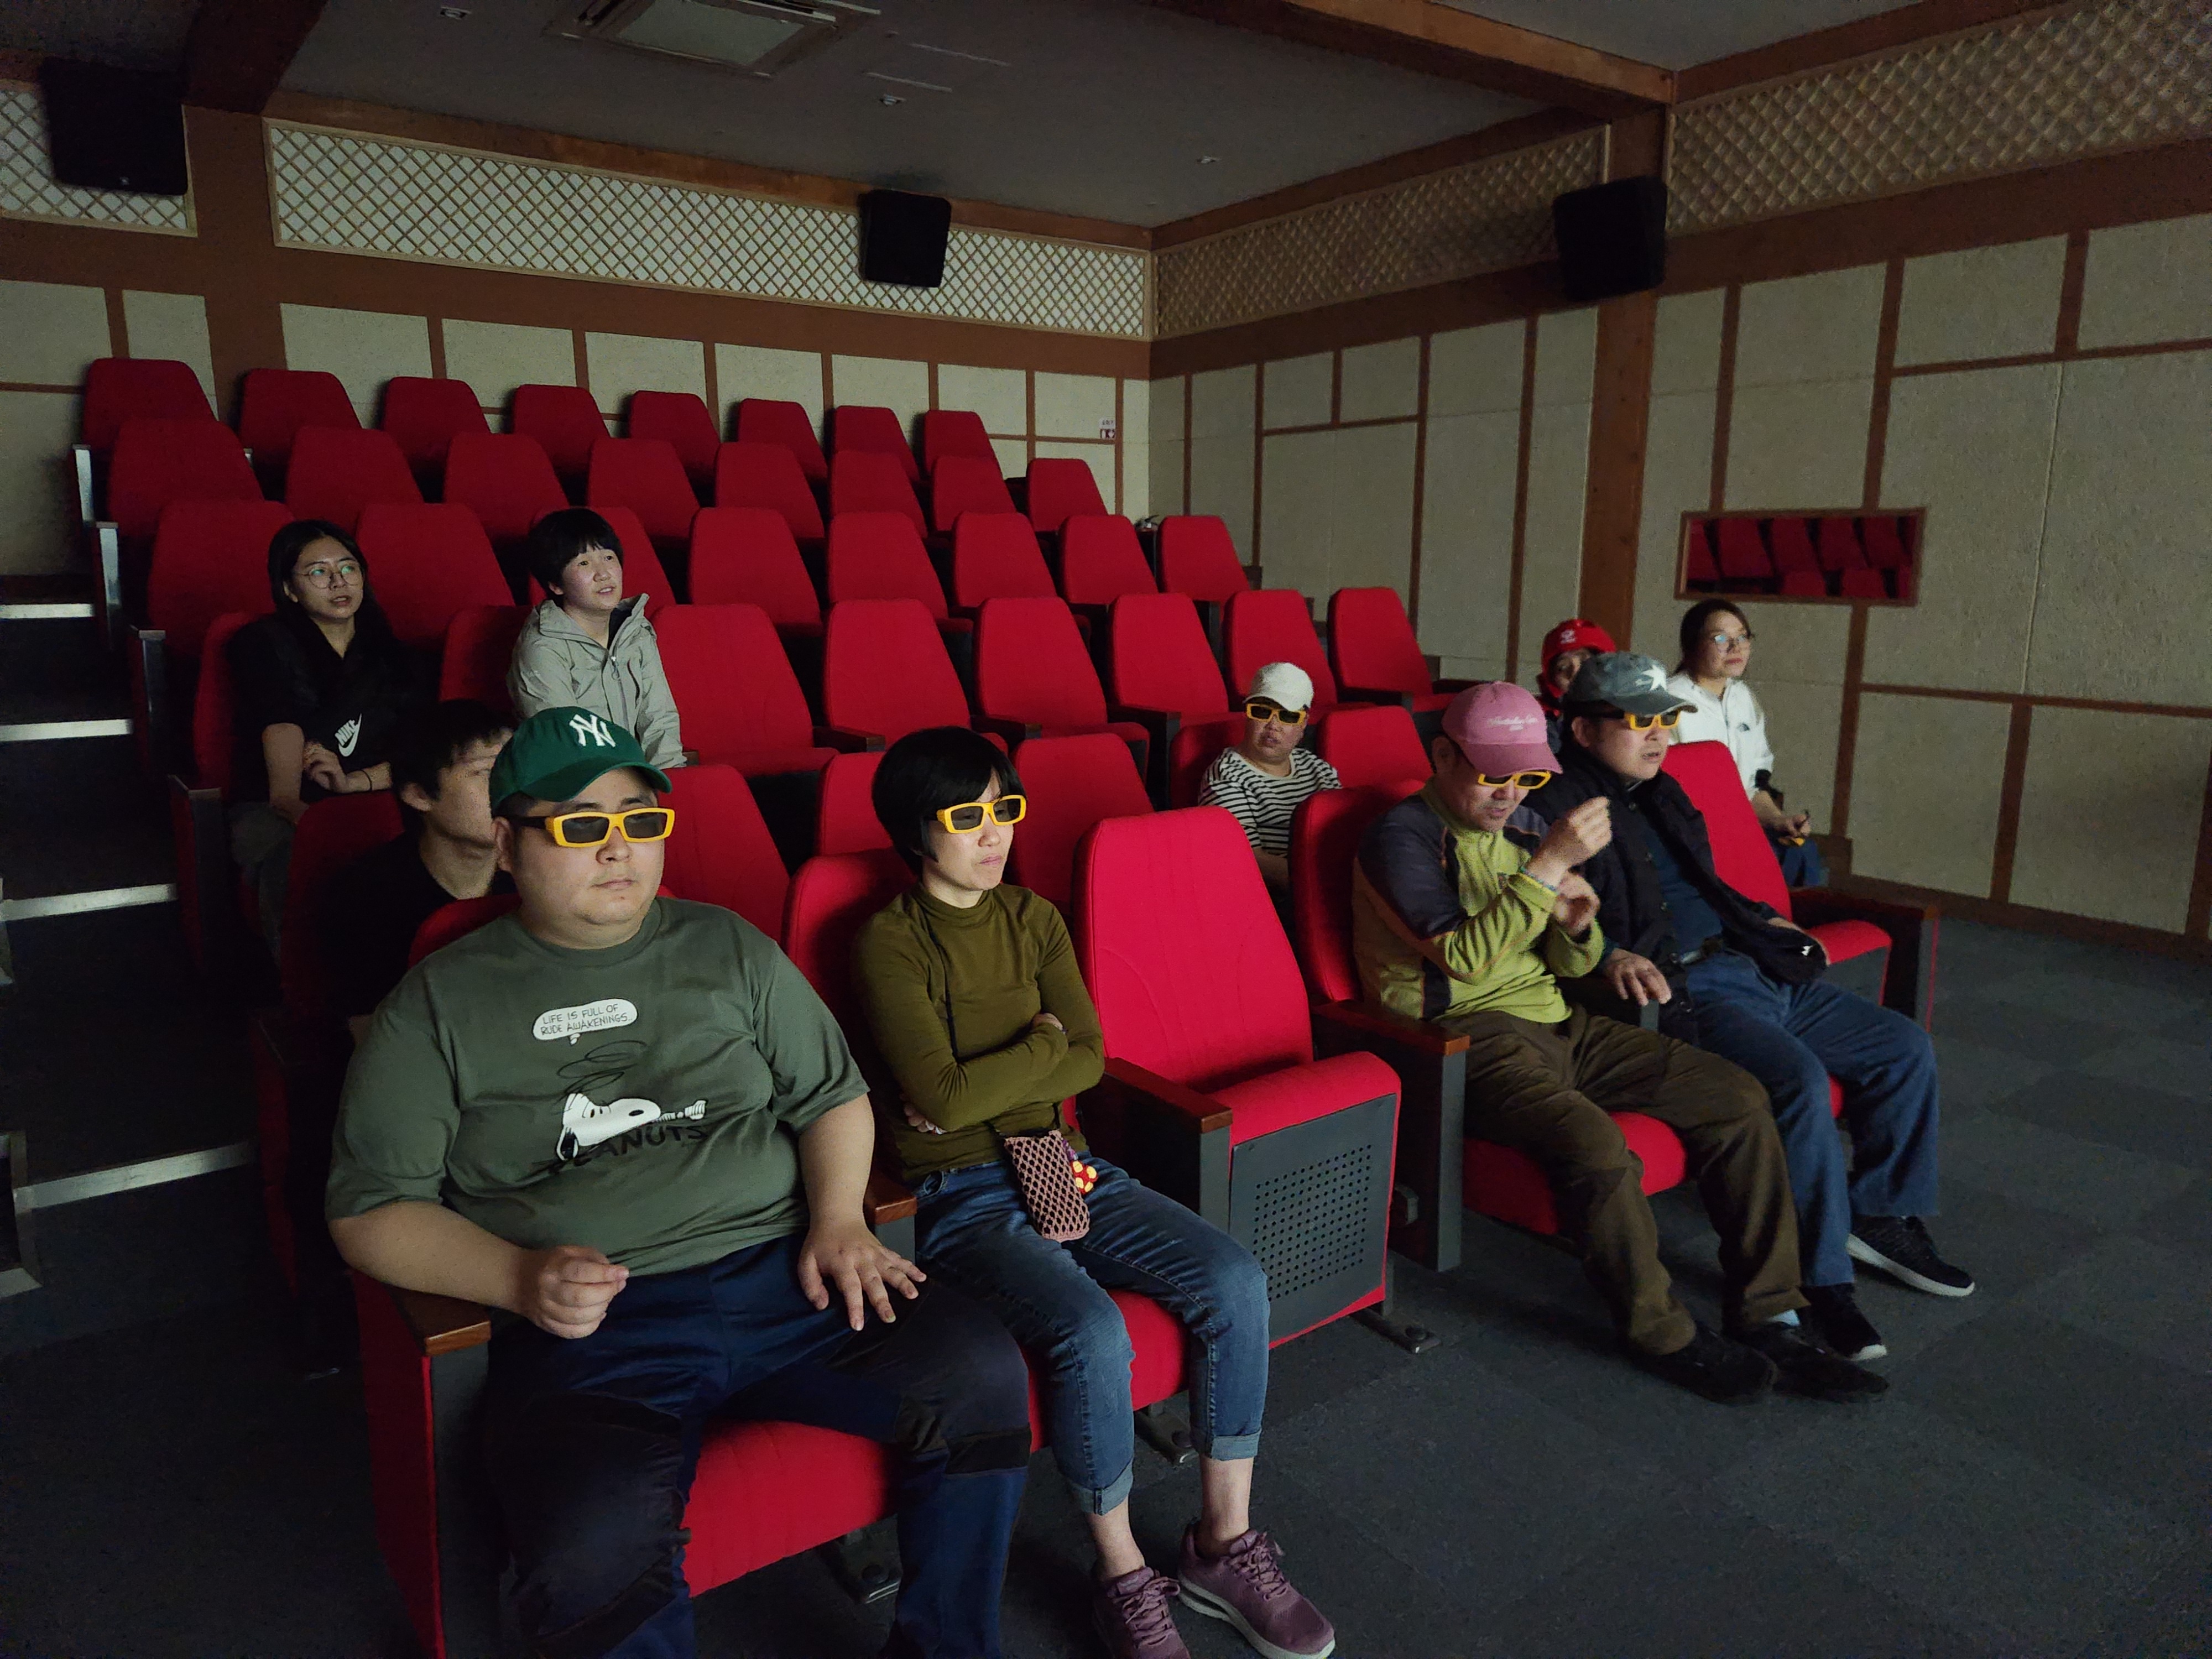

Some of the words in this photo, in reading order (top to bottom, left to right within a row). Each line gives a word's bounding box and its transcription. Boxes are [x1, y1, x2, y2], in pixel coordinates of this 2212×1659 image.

[542, 1014, 563, 1025] LIFE
[567, 1011, 578, 1020] IS
[582, 1007, 604, 1018] FULL
[606, 1003, 619, 1013] OF
[540, 1024, 563, 1036] RUDE
